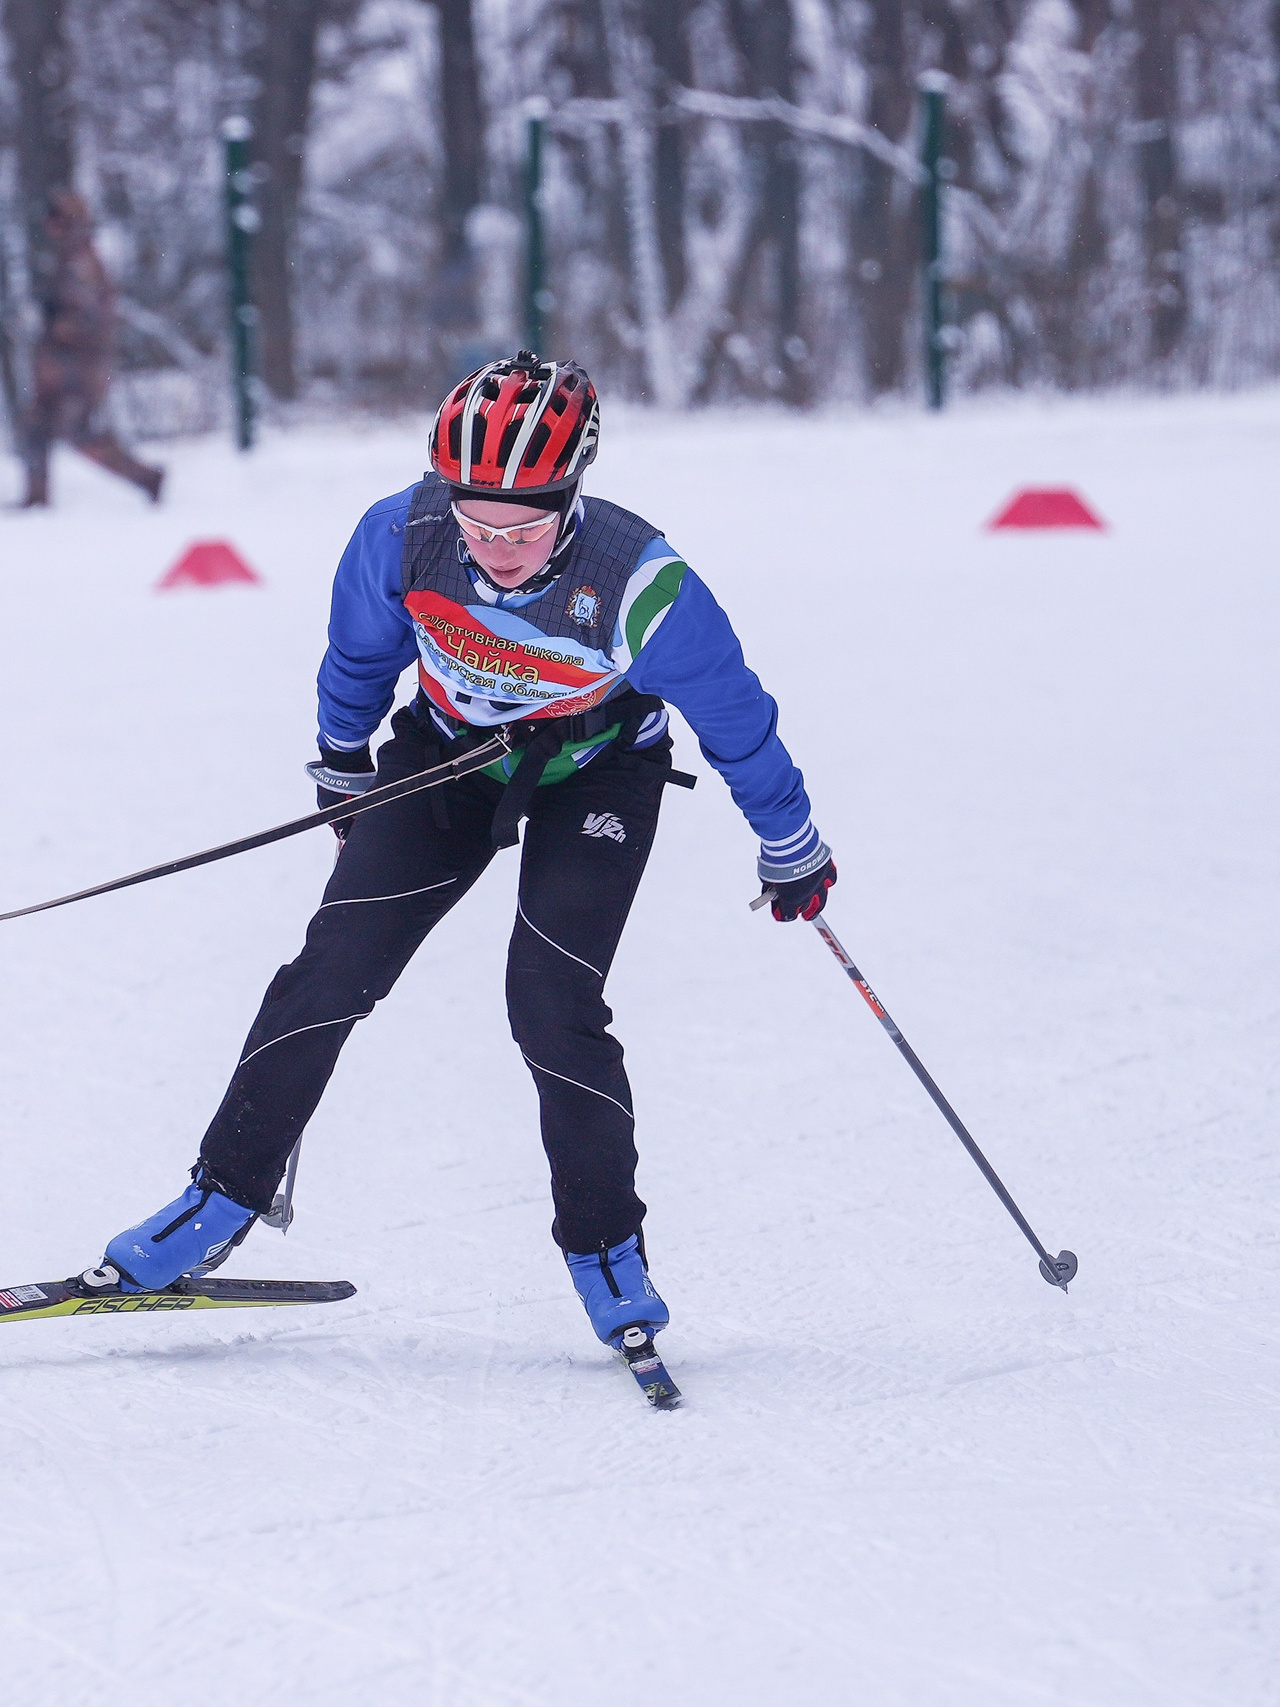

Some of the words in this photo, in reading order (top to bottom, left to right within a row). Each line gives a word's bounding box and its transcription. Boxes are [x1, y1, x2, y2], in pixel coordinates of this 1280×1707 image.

[446, 634, 540, 685] Чайка
[522, 643, 585, 667] школа
[70, 1296, 197, 1316] FISCHER
